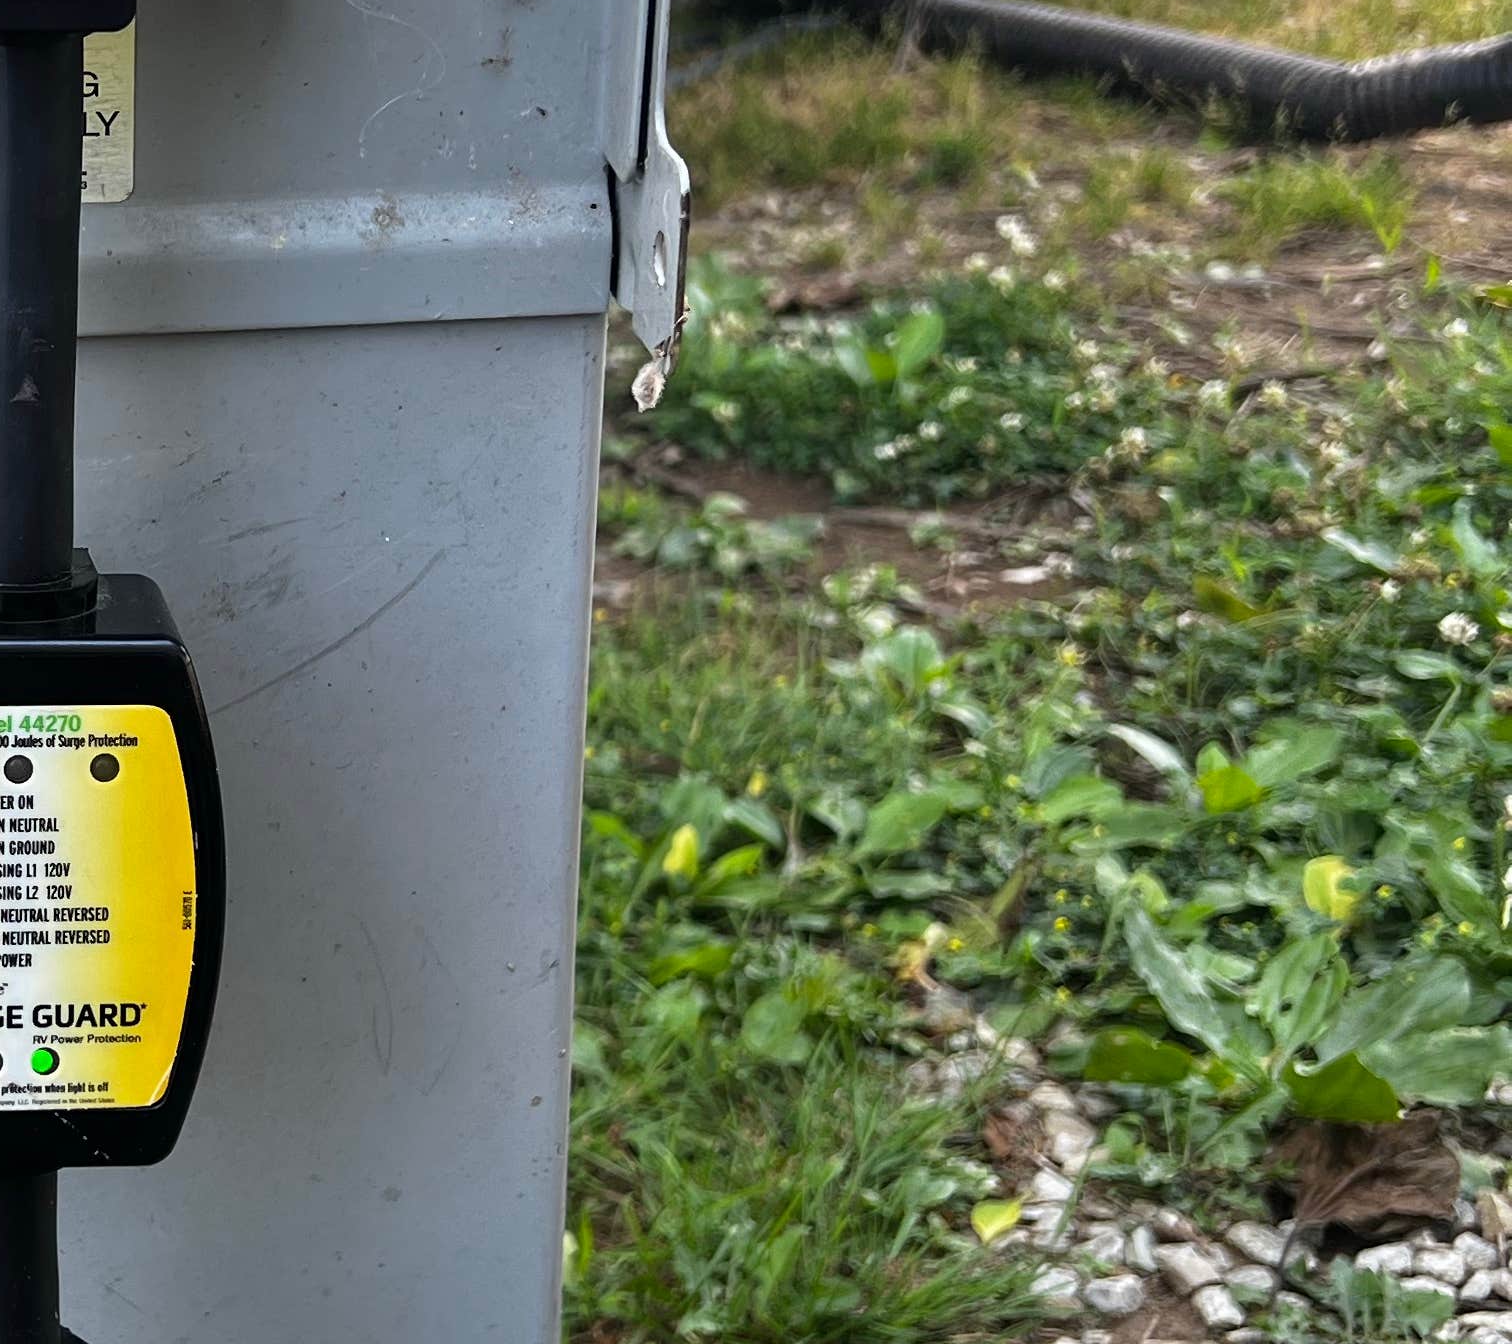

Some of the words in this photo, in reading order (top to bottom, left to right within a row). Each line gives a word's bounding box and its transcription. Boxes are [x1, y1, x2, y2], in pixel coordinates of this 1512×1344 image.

[18, 713, 82, 733] 44270
[11, 733, 44, 749] Joules
[45, 733, 57, 748] of
[58, 733, 86, 751] Surge
[88, 732, 138, 748] Protection
[18, 794, 35, 810] ON
[9, 817, 60, 833] NEUTRAL
[9, 840, 56, 856] GROUND
[26, 863, 37, 878] L1
[44, 862, 71, 878] 120V
[26, 885, 39, 900] L2
[46, 884, 73, 900] 120V
[0, 908, 50, 923] NEUTRAL
[53, 907, 110, 923] REVERSED
[2, 930, 52, 946] NEUTRAL
[55, 929, 111, 945] REVERSED
[32, 1035, 49, 1045] RV
[50, 1034, 84, 1045] Power
[87, 1033, 142, 1044] Protection
[1, 1083, 43, 1096] protection
[44, 1083, 66, 1094] when
[67, 1082, 86, 1095] light
[88, 1082, 96, 1093] is
[97, 1081, 110, 1093] off
